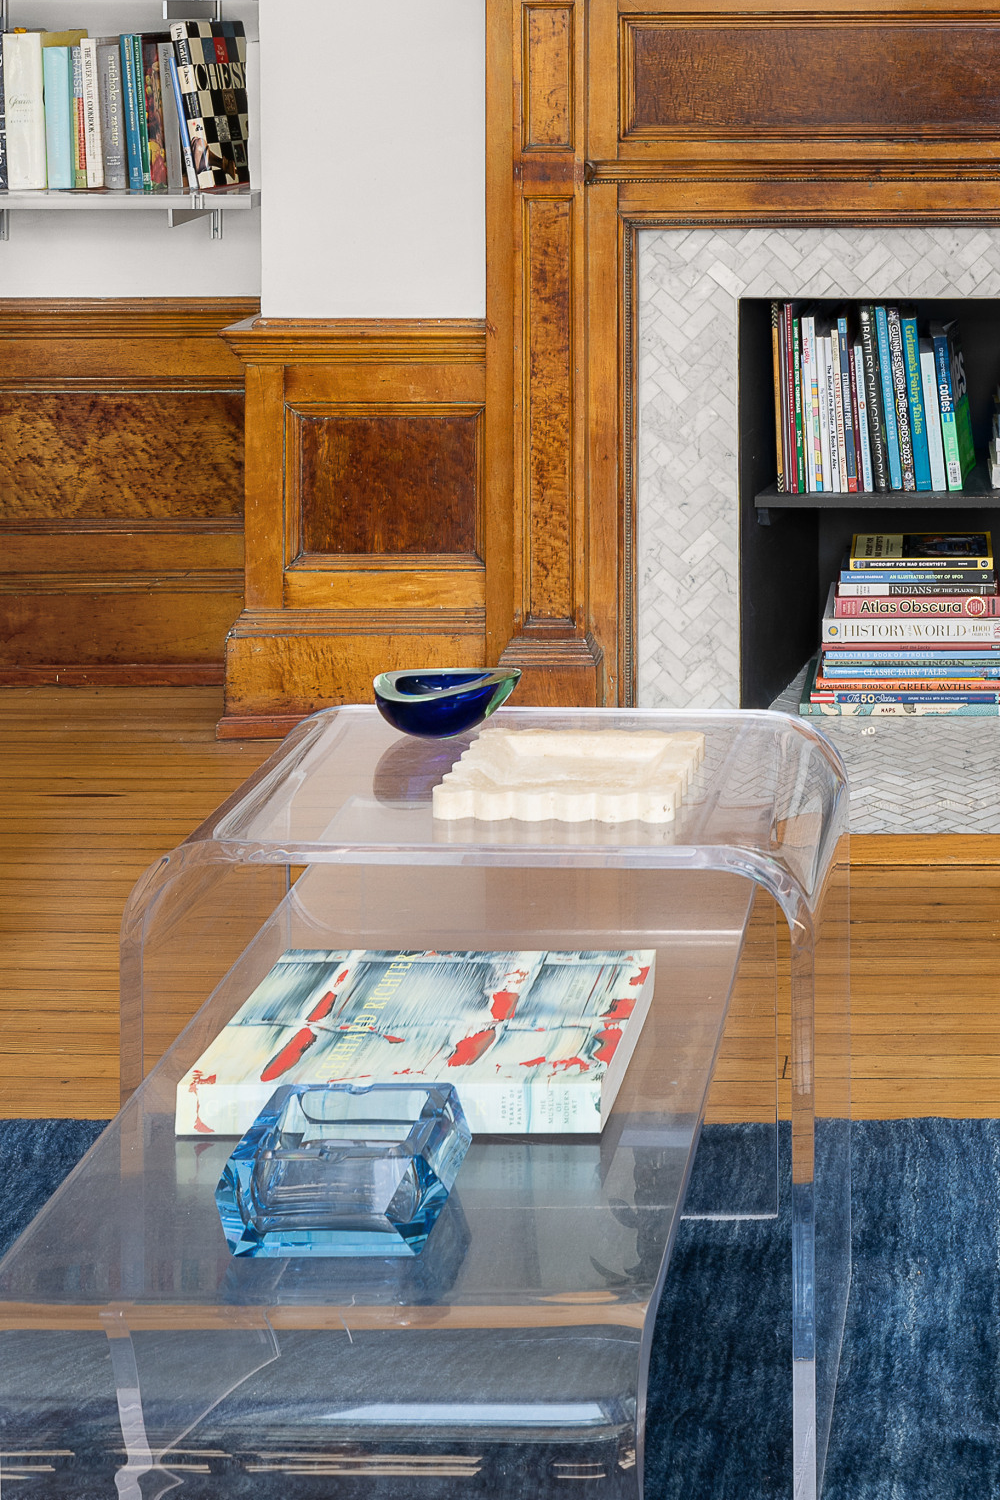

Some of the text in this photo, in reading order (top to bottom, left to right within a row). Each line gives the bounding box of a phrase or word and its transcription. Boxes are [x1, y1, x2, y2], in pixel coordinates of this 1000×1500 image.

[73, 50, 81, 94] BRAISE
[842, 372, 850, 412] EXTRAORDINARY
[890, 325, 910, 464] GUINNESS WORLD RECORDS 2023
[905, 325, 922, 434] Grimm's Fairy Tales
[940, 384, 951, 412] codes
[860, 600, 962, 613] Atlas Obscura
[844, 624, 966, 636] HISTORY WORLD
[898, 683, 933, 691] GREEK
[315, 953, 416, 1080] GERHARD RICHTER
